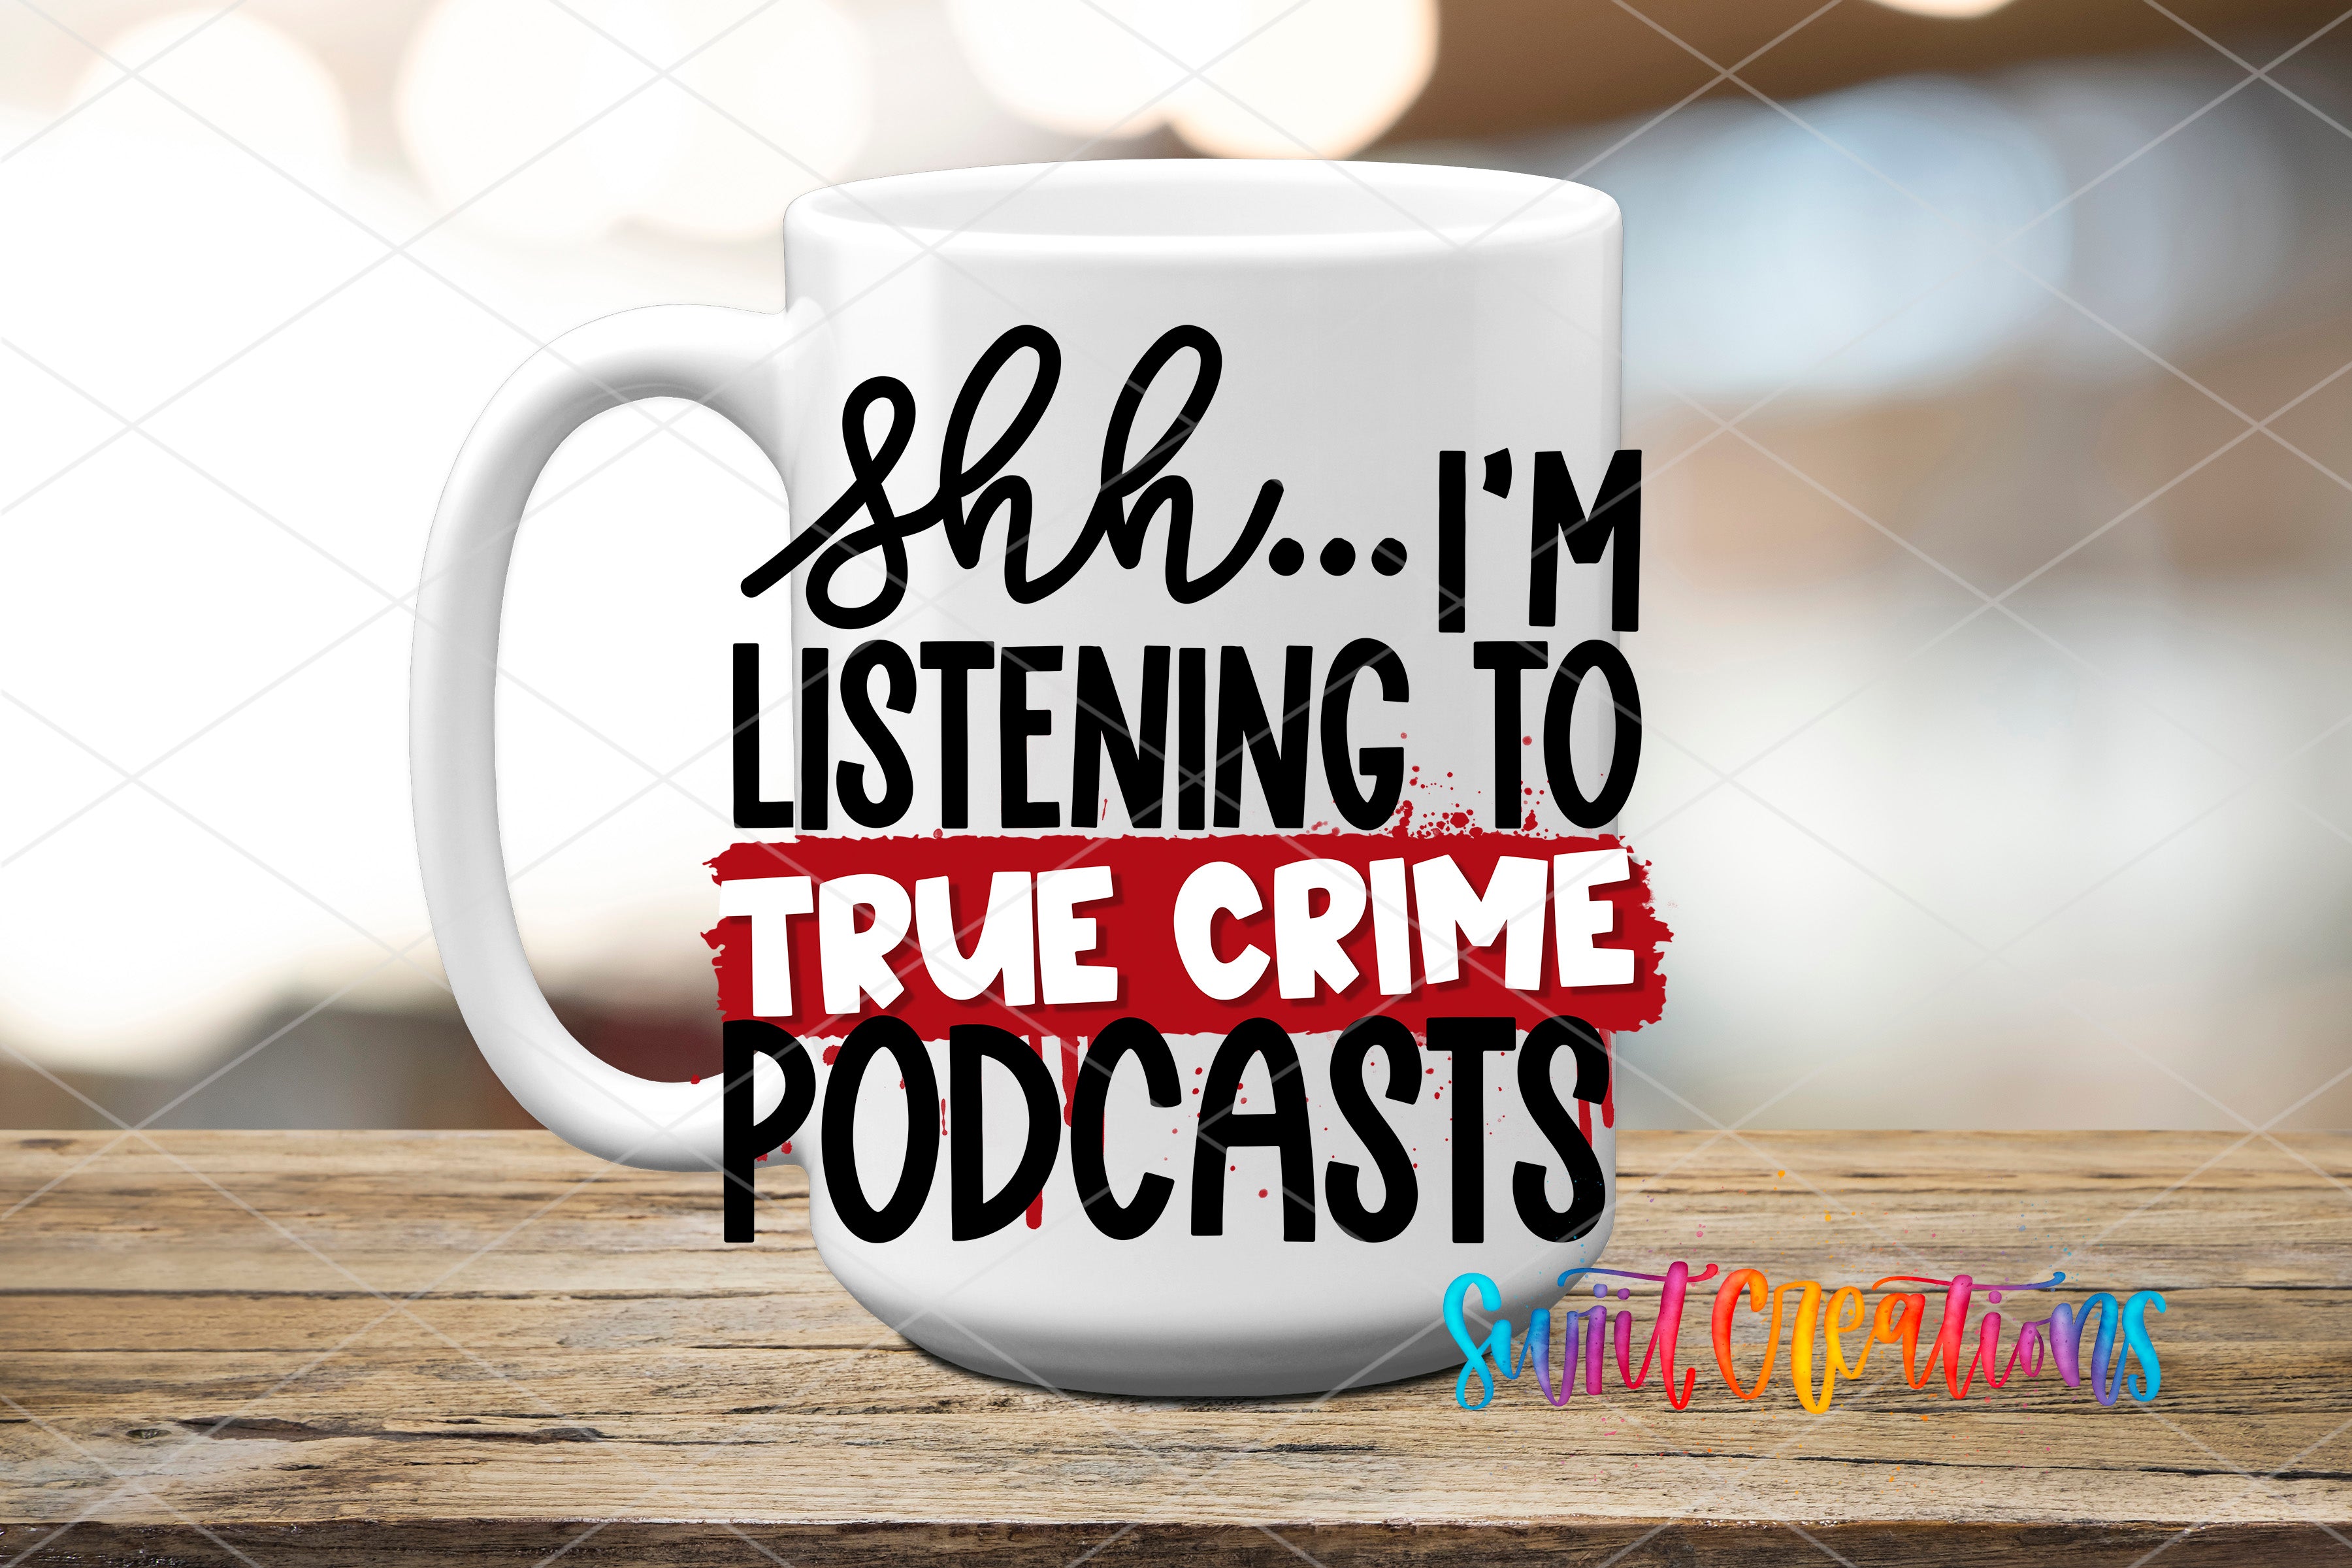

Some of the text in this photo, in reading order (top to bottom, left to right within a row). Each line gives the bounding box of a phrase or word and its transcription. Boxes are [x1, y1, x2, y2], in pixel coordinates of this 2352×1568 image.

[741, 325, 1642, 632] shh... I'M
[733, 638, 1642, 831] LISTENING TO
[719, 848, 1635, 1017] TRUE CRIME
[723, 1015, 1610, 1244] PODCASTS
